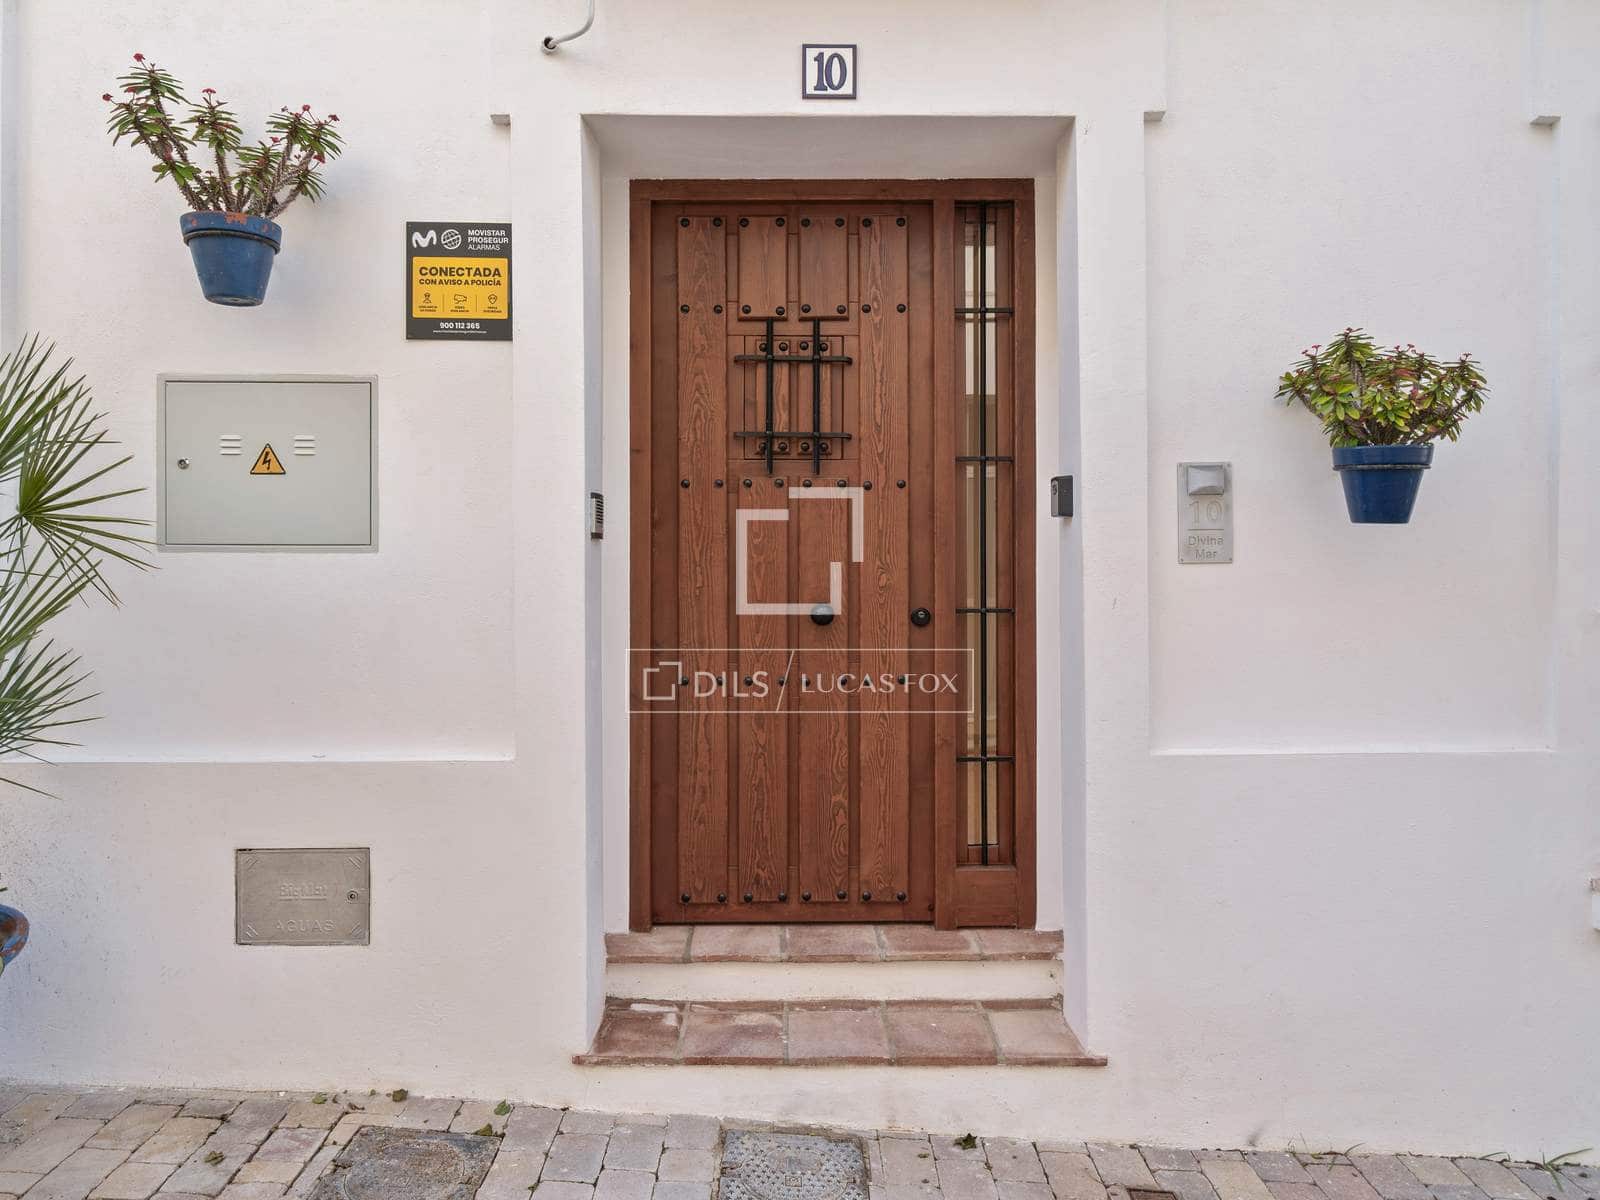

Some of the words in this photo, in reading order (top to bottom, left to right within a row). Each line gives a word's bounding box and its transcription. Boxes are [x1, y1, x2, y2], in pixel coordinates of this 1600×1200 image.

[813, 51, 848, 91] 10
[467, 229, 506, 237] MOVISTAR
[467, 236, 509, 244] PROSEGUR
[418, 266, 502, 277] CONECTADA
[418, 278, 437, 286] CON
[438, 278, 463, 286] AVISO
[471, 278, 502, 286] POLICÍA
[1189, 500, 1224, 525] 10
[1187, 535, 1225, 546] Divina
[1195, 549, 1218, 560] Mar
[273, 919, 336, 933] AGUAS
